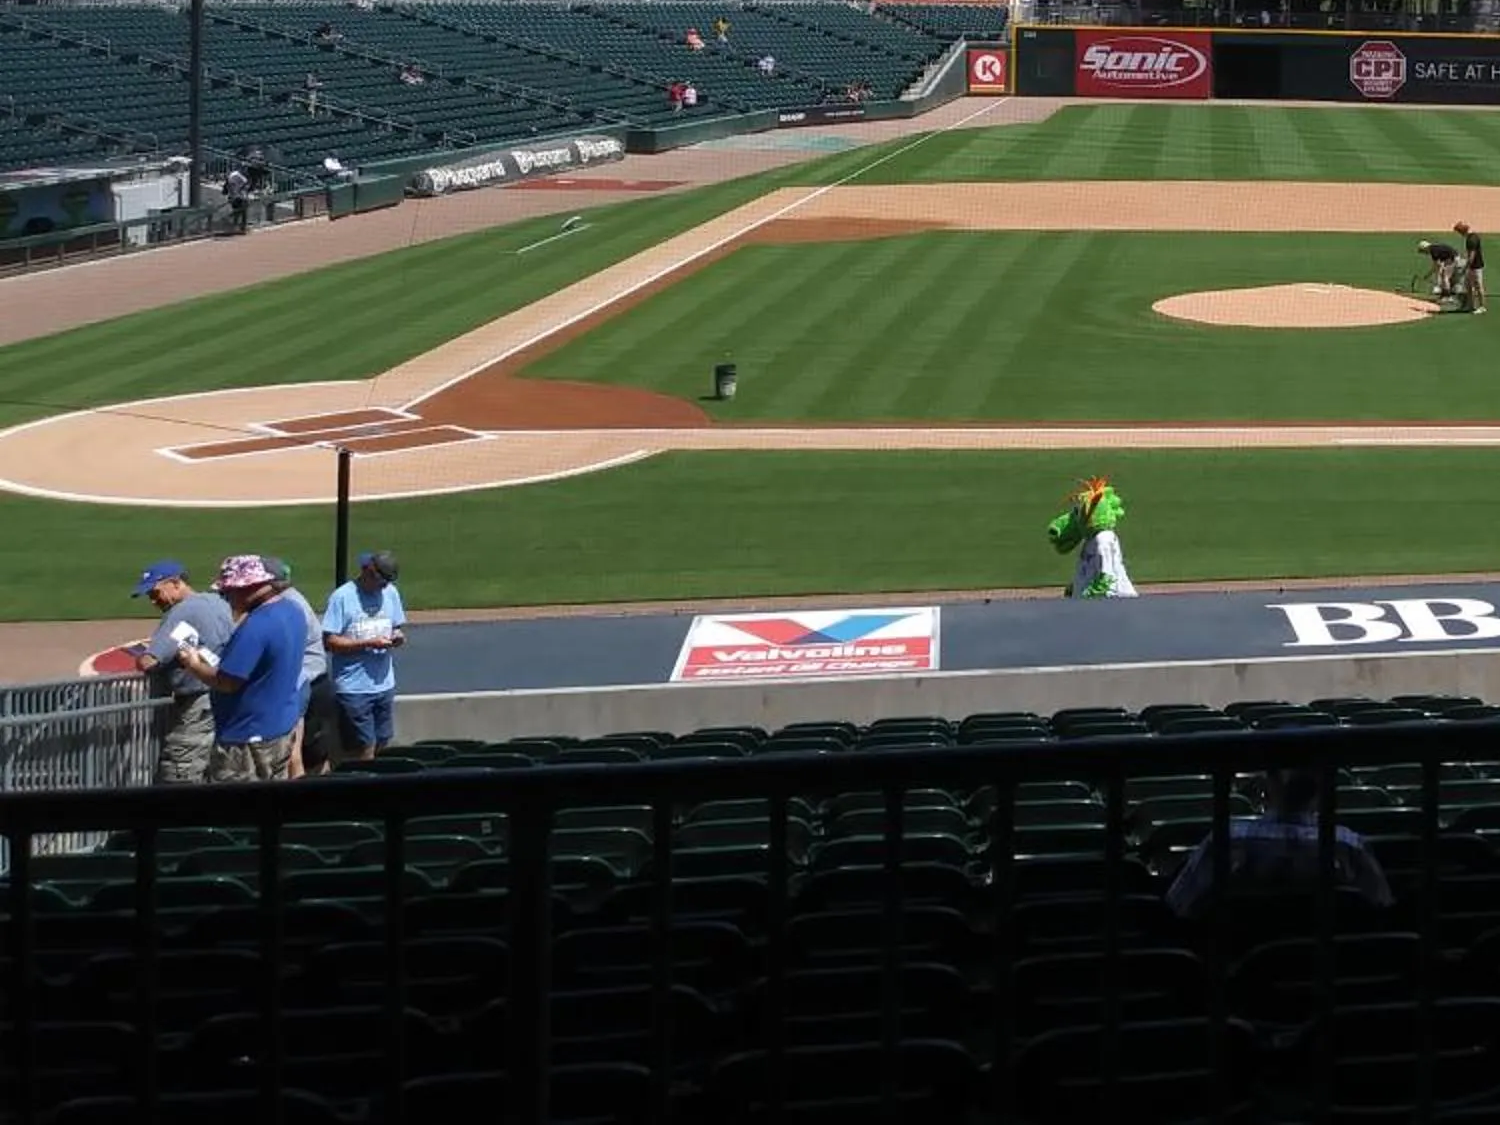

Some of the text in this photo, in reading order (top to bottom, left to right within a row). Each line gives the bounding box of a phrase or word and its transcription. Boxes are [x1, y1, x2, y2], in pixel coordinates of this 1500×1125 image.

[1079, 45, 1190, 71] Sonic
[1092, 70, 1180, 80] Automotive
[1354, 60, 1401, 78] CPI
[1414, 62, 1459, 80] SAFE
[1464, 64, 1485, 80] AT
[713, 643, 907, 662] Valvoline
[696, 659, 919, 675] Instant Oil Change
